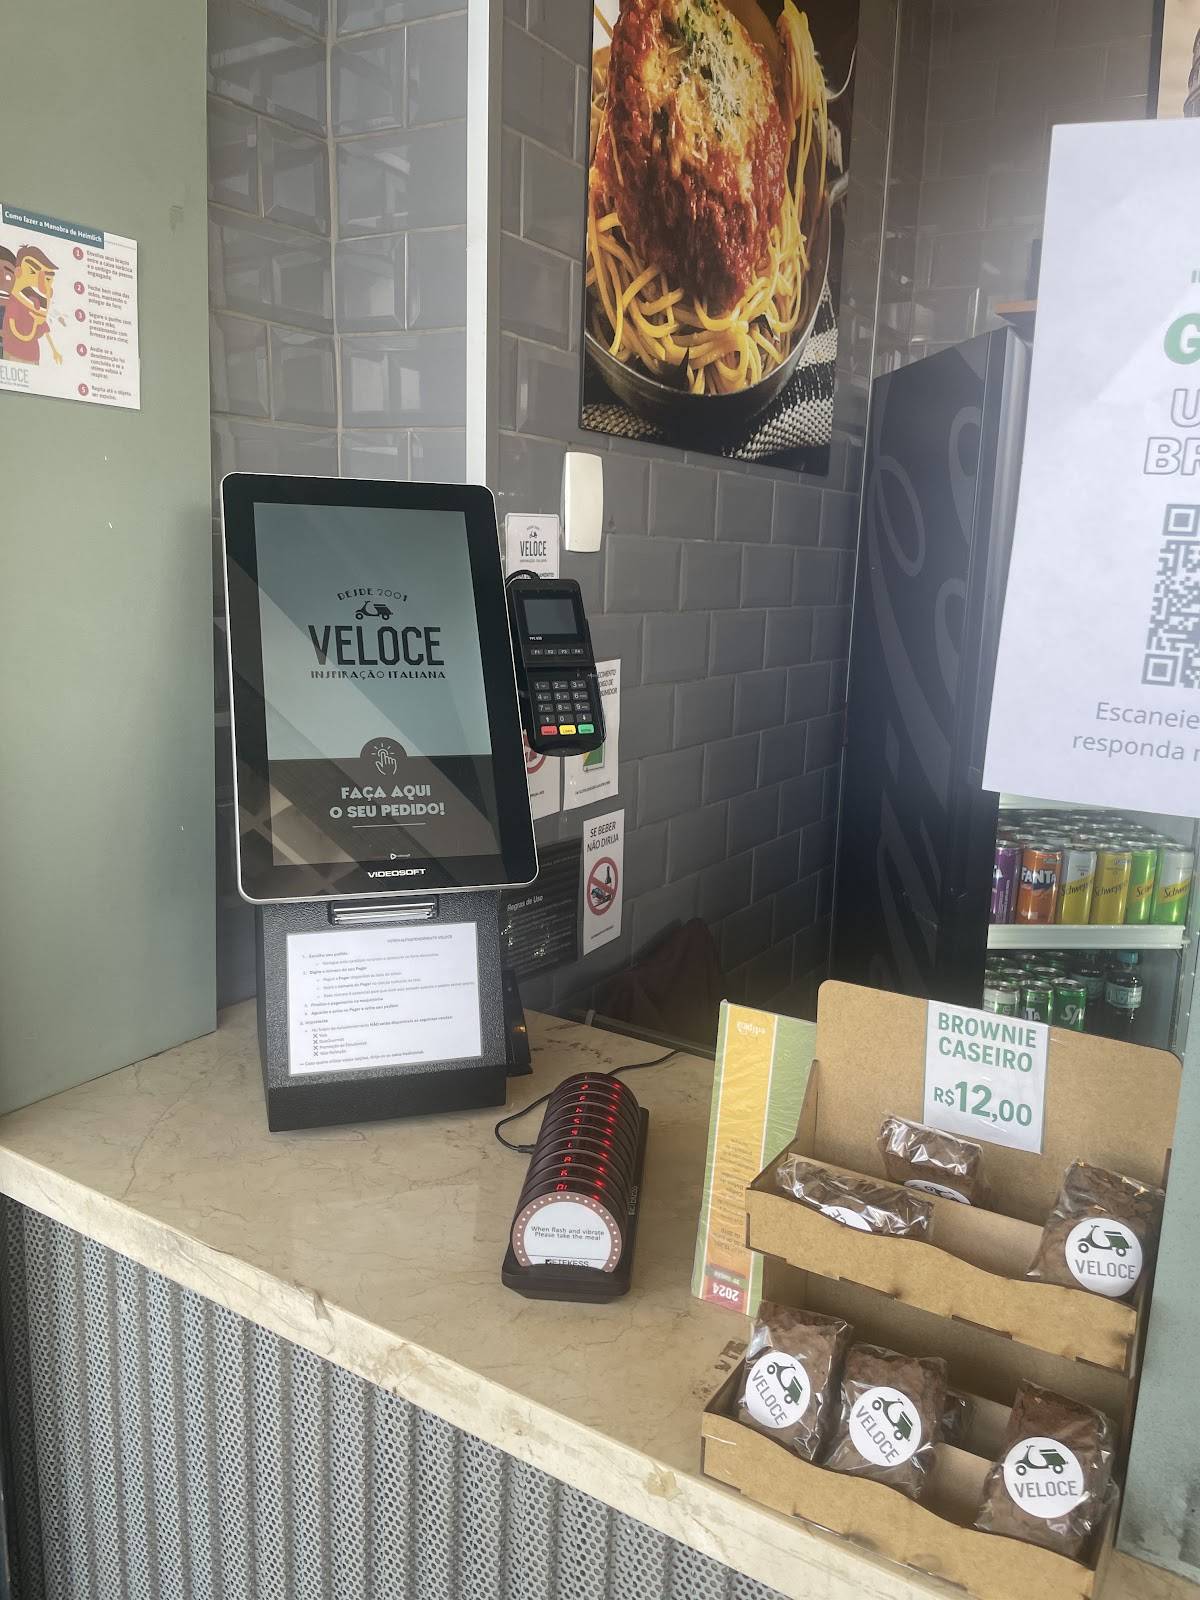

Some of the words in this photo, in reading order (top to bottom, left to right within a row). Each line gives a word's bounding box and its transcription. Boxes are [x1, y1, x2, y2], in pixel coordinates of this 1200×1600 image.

[4, 211, 22, 222] Como
[23, 215, 38, 225] fazer
[44, 221, 69, 234] Manobra
[70, 228, 77, 236] de
[77, 230, 102, 242] Heimlich
[519, 540, 547, 557] VELOCE
[307, 624, 445, 666] VELOCE
[311, 670, 385, 680] INSPIRAÇÃO
[388, 670, 446, 679] ITALIANA
[1096, 701, 1200, 730] Escaneie
[1072, 735, 1184, 761] responda
[341, 785, 387, 801] FAÇA
[391, 784, 431, 800] AQUI
[329, 806, 343, 819] O
[347, 805, 377, 818] SEU
[381, 802, 446, 817] PEDIDO!
[598, 821, 616, 835] BEBER
[367, 868, 427, 878] VIDEOSOFT
[1021, 866, 1057, 884] FANTA
[938, 1012, 1036, 1049] BROWNIE
[938, 1036, 1032, 1072] CASEIRO
[934, 1081, 1032, 1127] R$12,00
[1075, 1259, 1136, 1280] VELOCE
[712, 1282, 740, 1302] 2024
[751, 1369, 787, 1426] VELOCE
[855, 1405, 900, 1464] VELOCE
[1014, 1480, 1078, 1498] VELOCE
